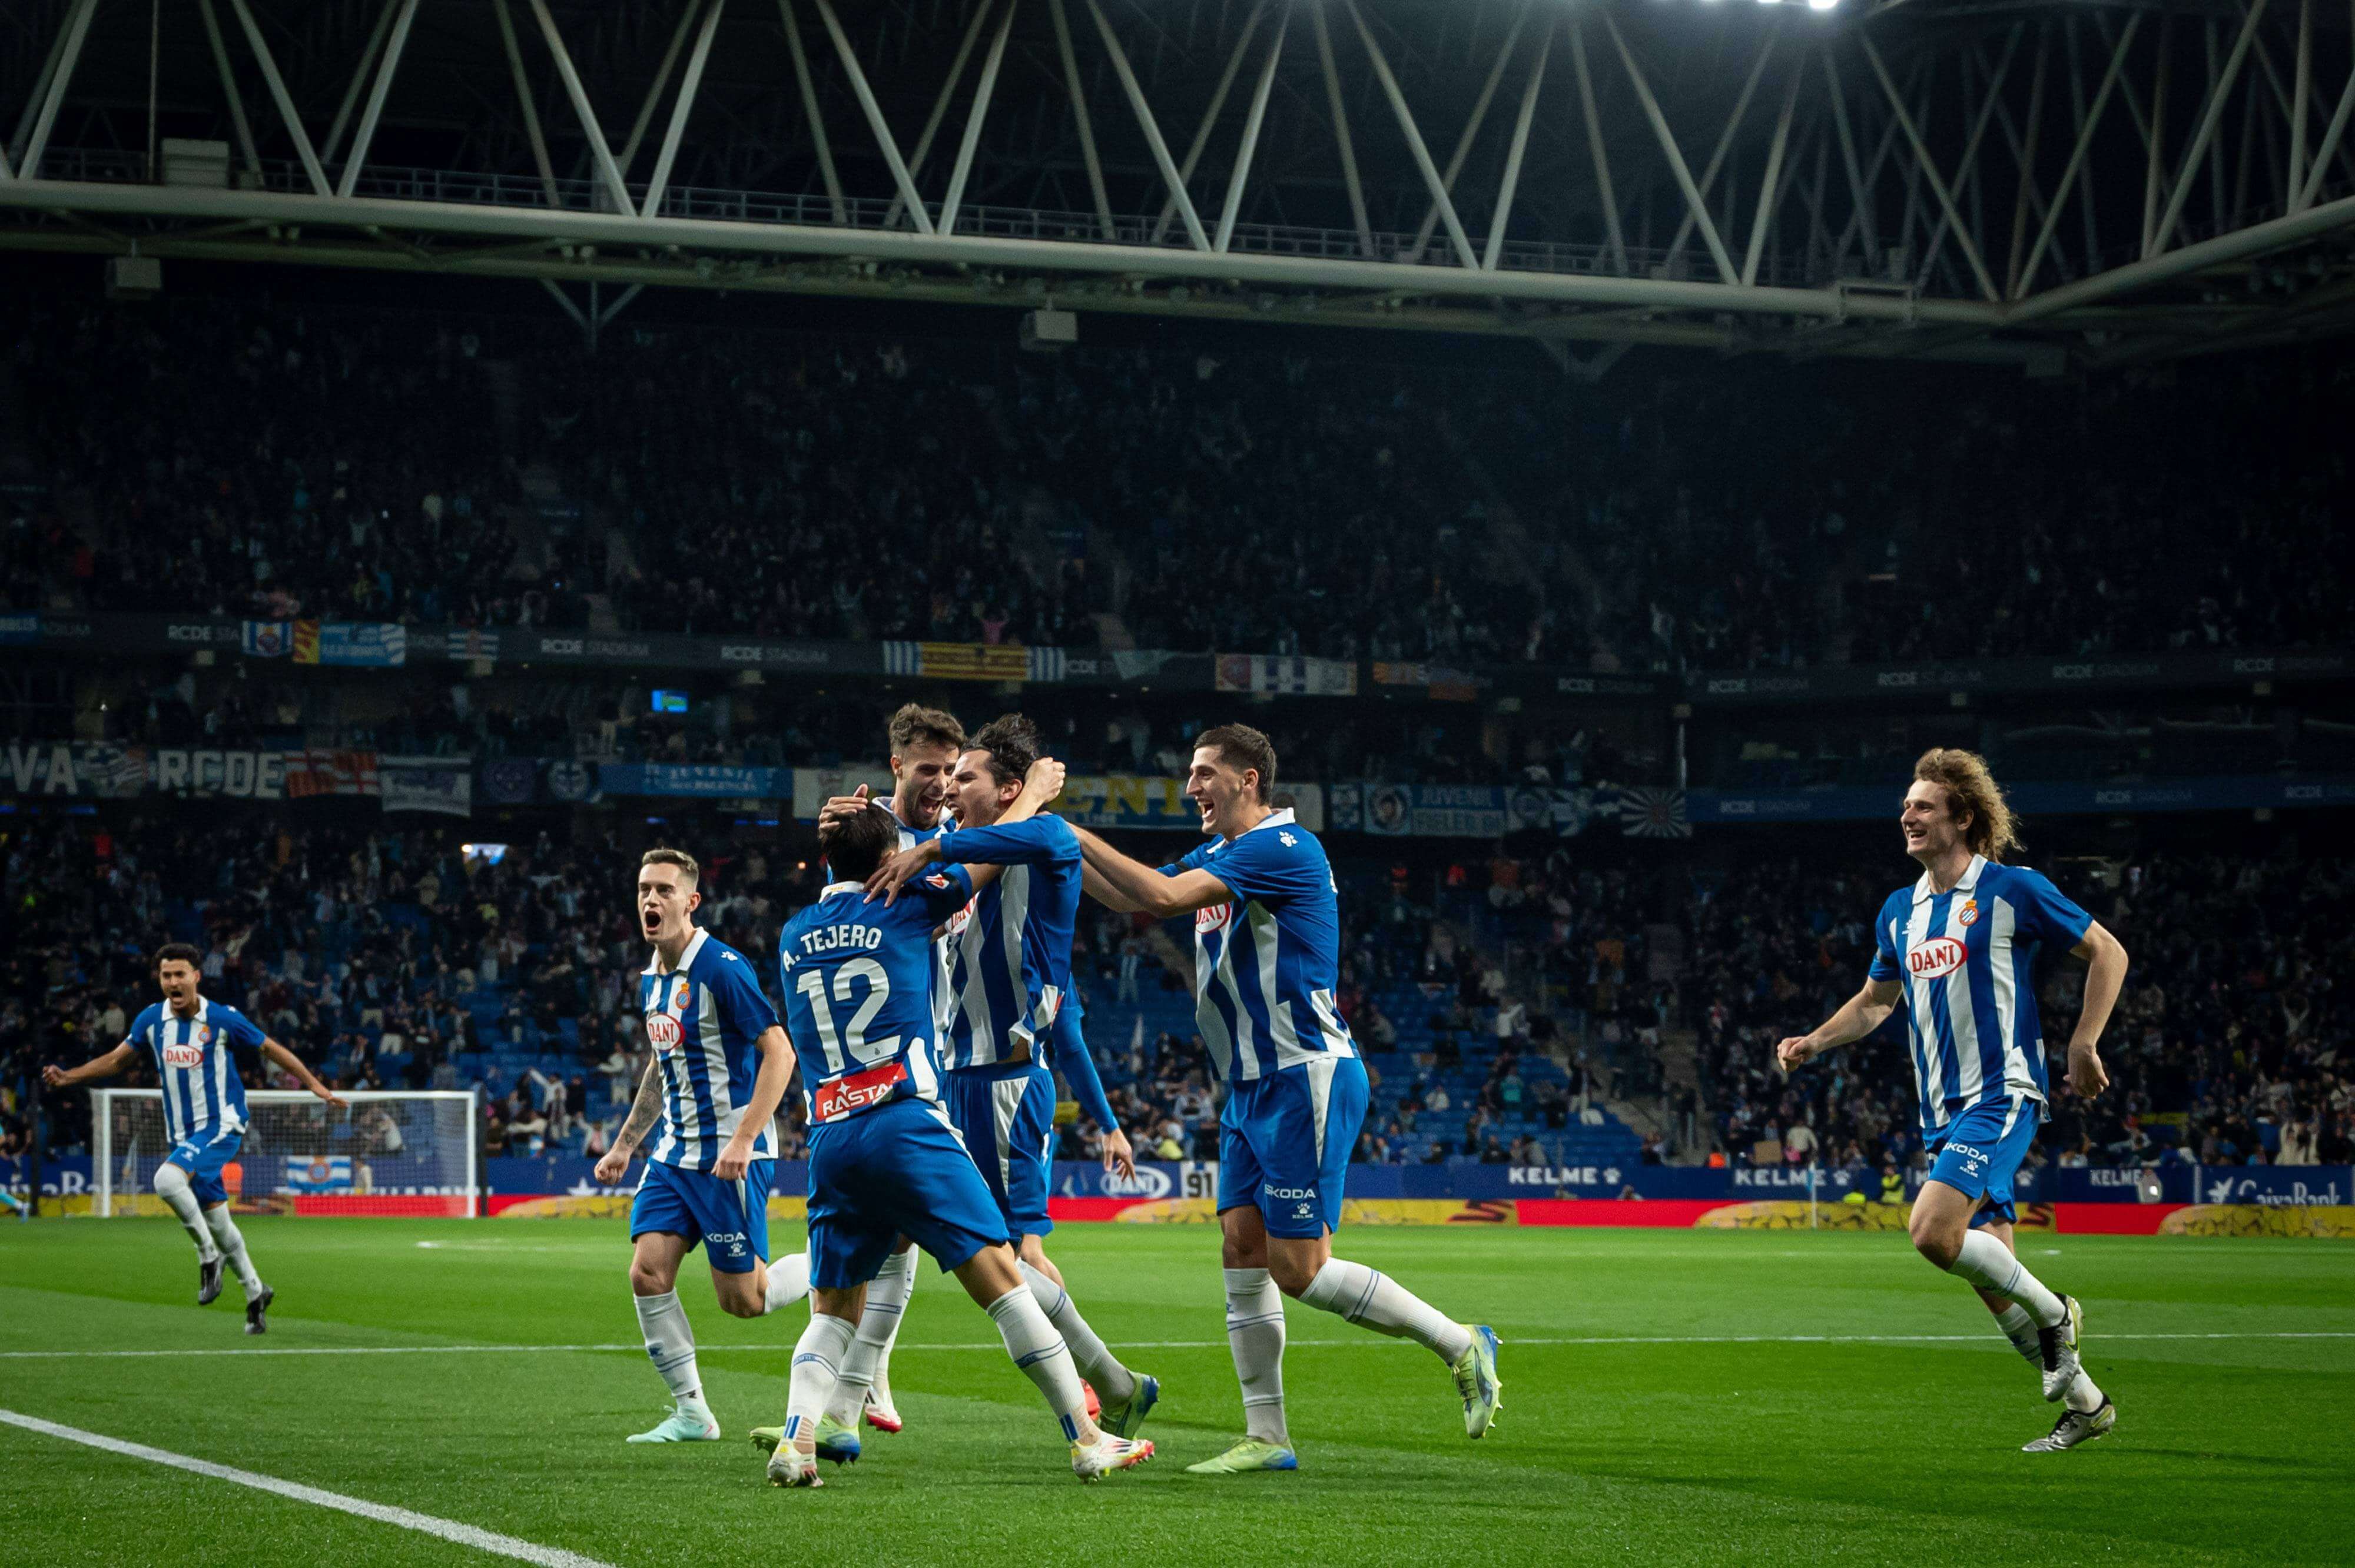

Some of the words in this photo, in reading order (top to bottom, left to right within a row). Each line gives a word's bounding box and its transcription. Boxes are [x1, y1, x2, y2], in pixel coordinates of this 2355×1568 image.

[158, 750, 284, 799] RCDE
[782, 950, 801, 972] A.
[800, 924, 883, 955] TEJERO
[1911, 944, 1955, 972] DANI
[796, 958, 901, 1074] 12
[649, 1023, 674, 1042] DANI
[165, 1049, 195, 1063] DANI
[822, 1083, 890, 1116] RASTA
[1187, 1173, 1212, 1197] 91
[1508, 1167, 1598, 1185] KELME
[1734, 1168, 1826, 1187] KELME
[2090, 1169, 2142, 1187] KELME
